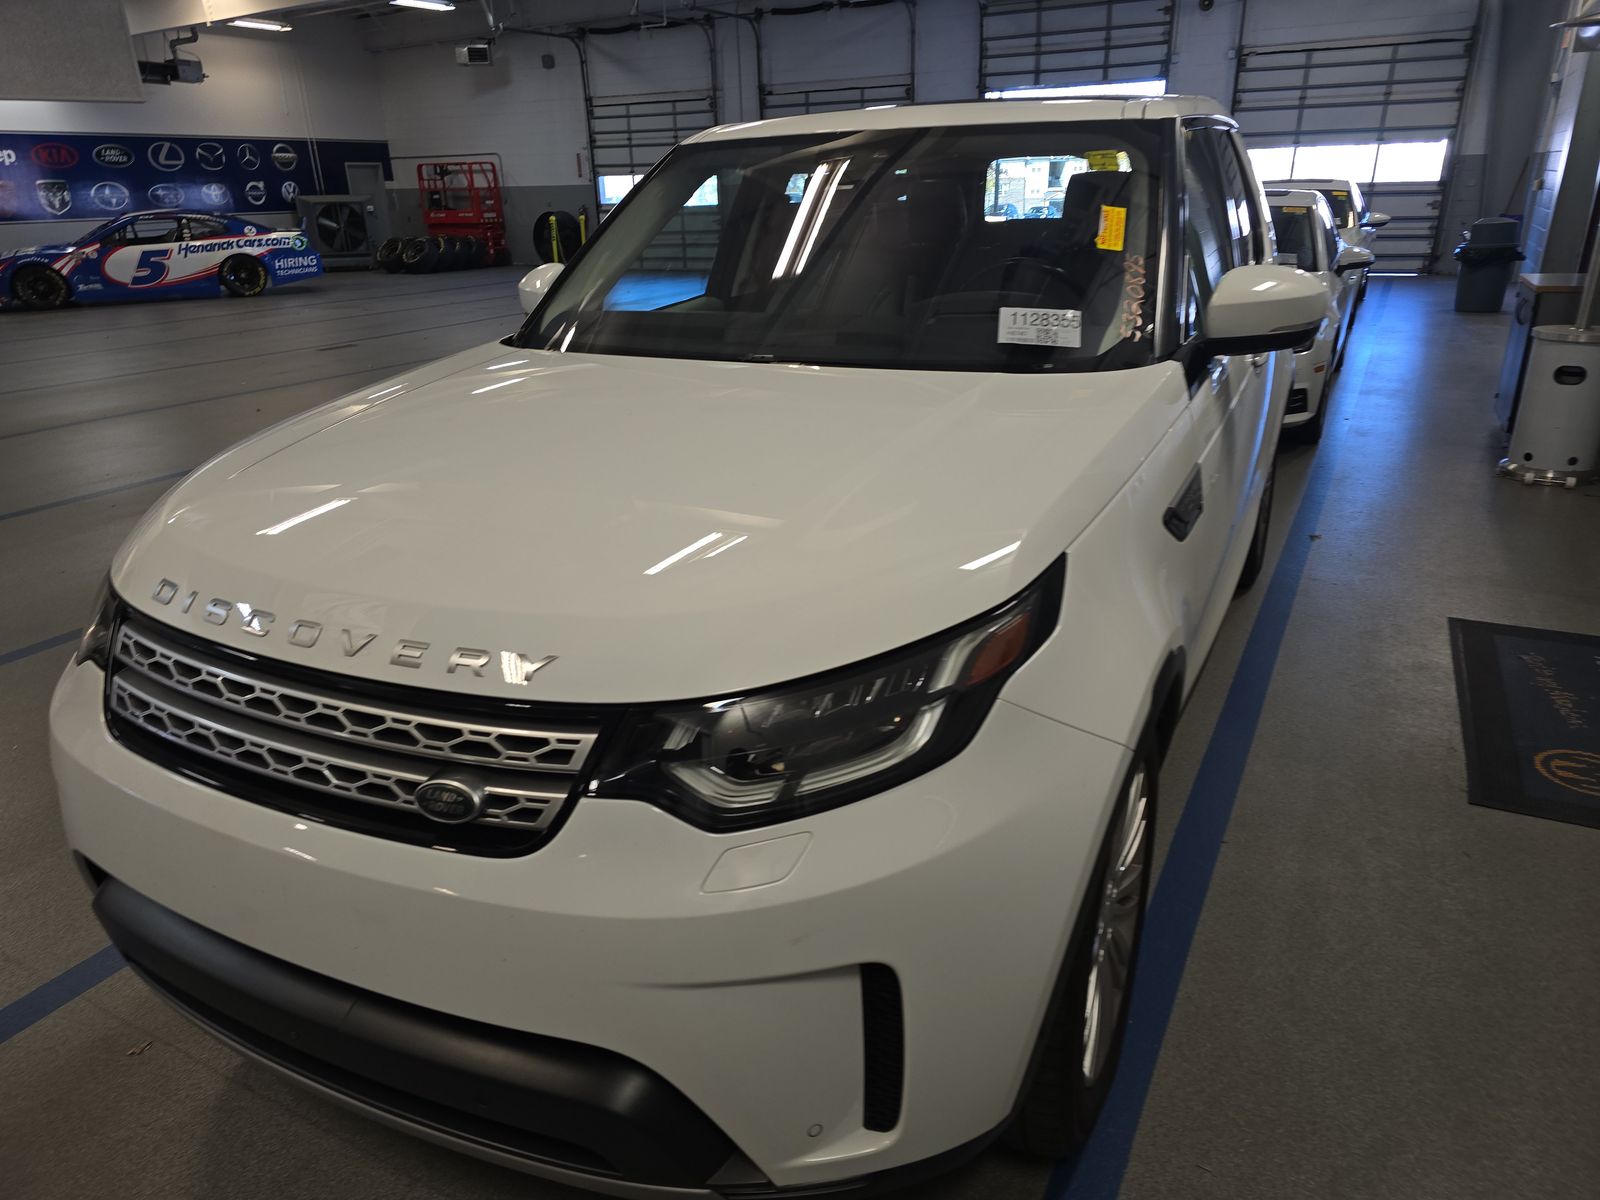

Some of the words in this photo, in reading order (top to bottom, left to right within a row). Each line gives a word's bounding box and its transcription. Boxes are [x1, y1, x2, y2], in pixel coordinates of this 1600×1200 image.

[128, 249, 173, 288] 5
[275, 256, 317, 269] HIRING
[152, 577, 560, 686] DISCOVERY
